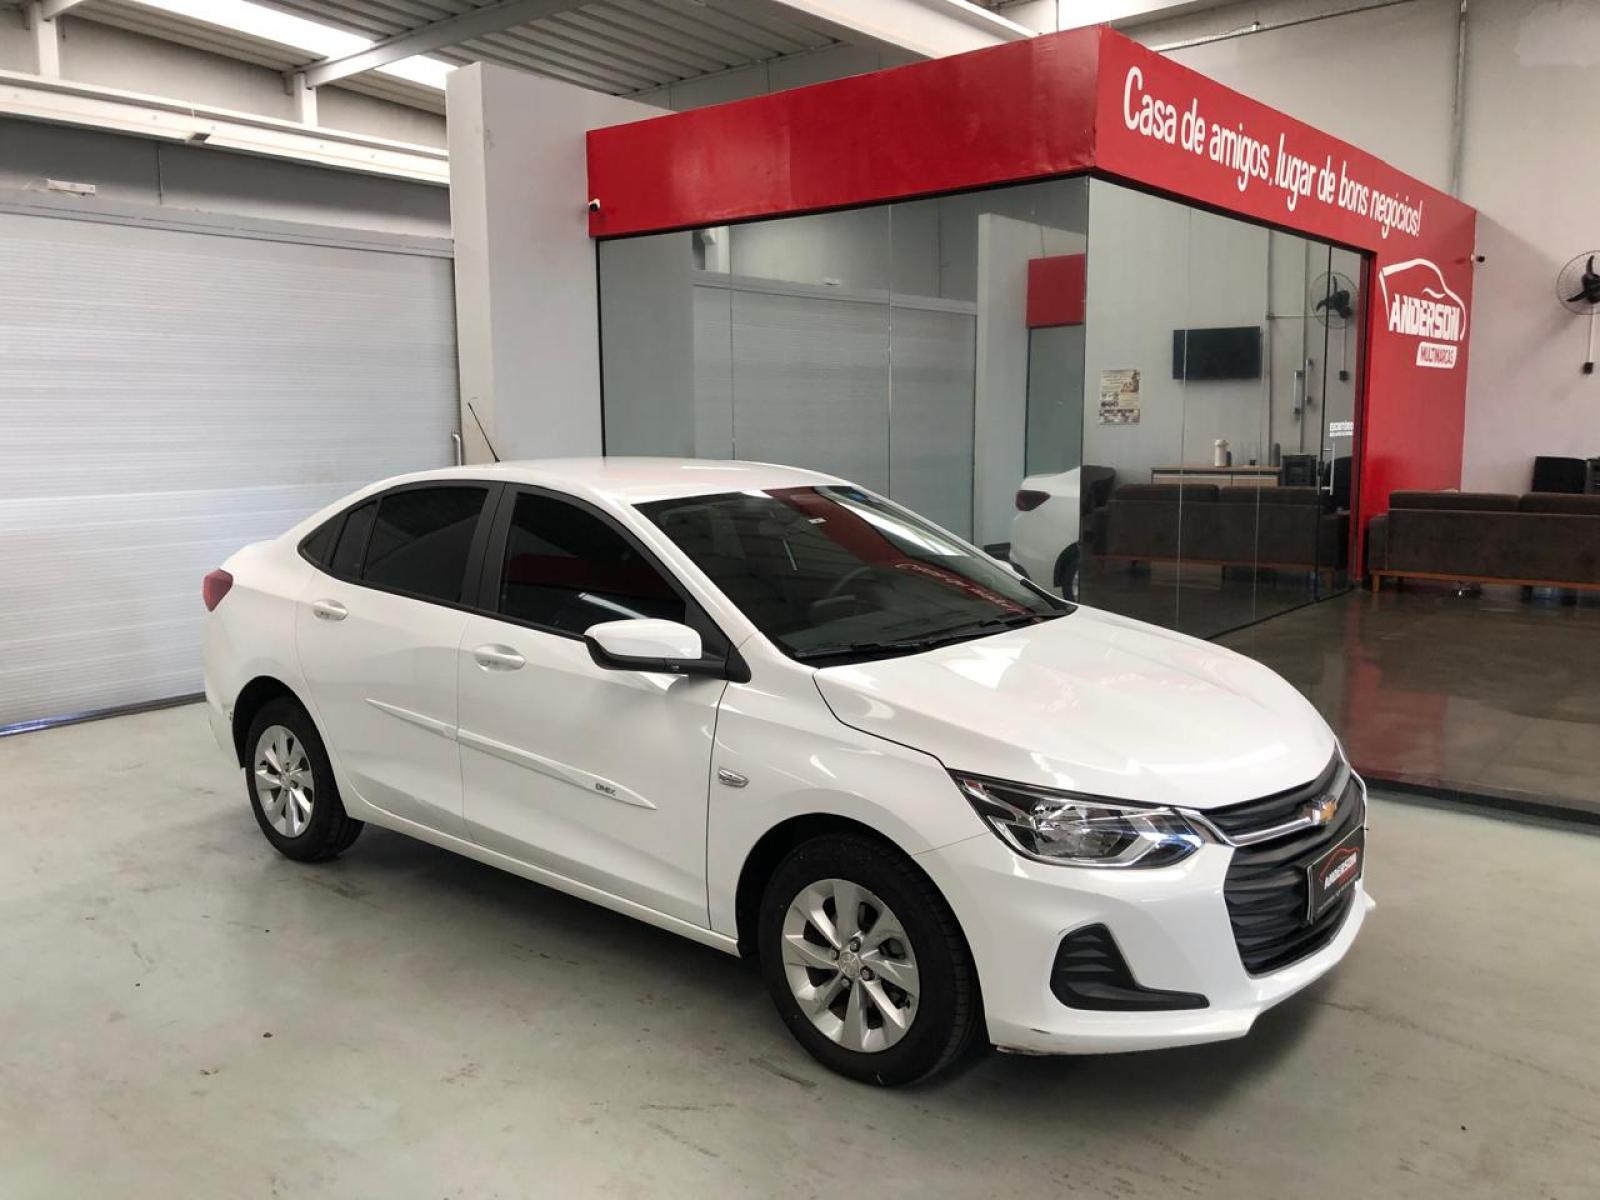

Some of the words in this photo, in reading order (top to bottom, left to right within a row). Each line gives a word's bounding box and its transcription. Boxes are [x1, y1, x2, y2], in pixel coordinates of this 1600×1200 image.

[1124, 66, 1177, 144] Casa
[1181, 98, 1205, 155] de
[1209, 122, 1272, 192] amigos,
[1275, 132, 1317, 212] lugar
[1317, 154, 1336, 204] de
[1338, 160, 1370, 216] bons
[1369, 189, 1423, 239] negócios!
[1388, 293, 1460, 342] ANDERSON
